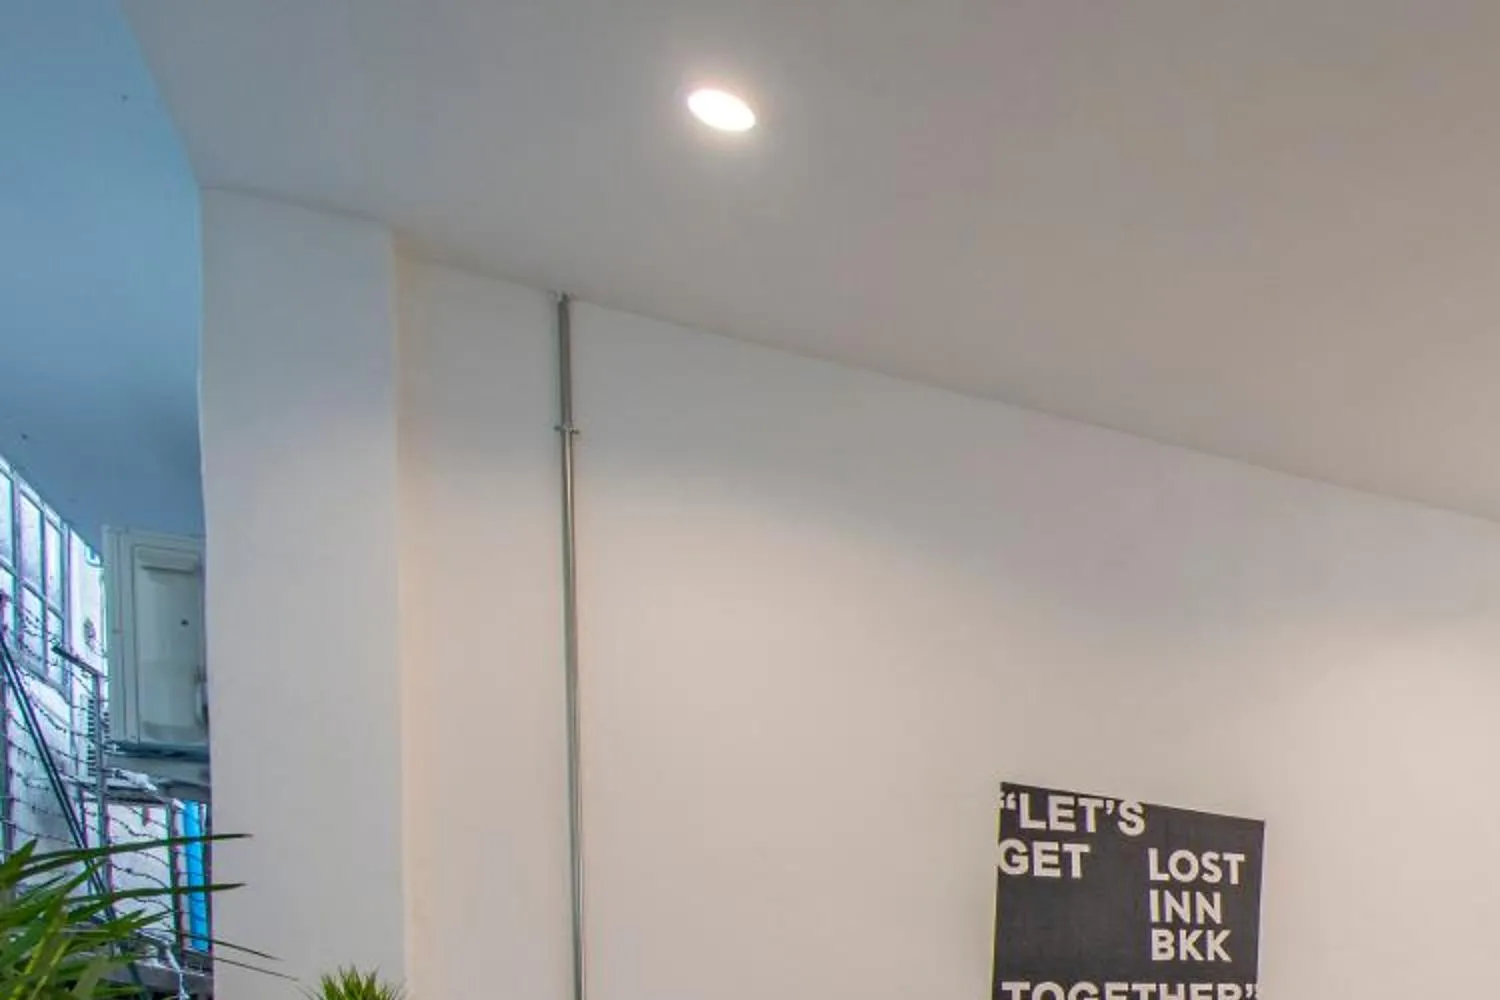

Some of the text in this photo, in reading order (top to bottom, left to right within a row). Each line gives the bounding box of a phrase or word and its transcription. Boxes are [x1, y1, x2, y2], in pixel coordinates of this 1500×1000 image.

[998, 838, 1091, 879] GET
[1147, 847, 1246, 885] LOST
[1149, 889, 1223, 925] INN
[1150, 927, 1233, 963] BKK
